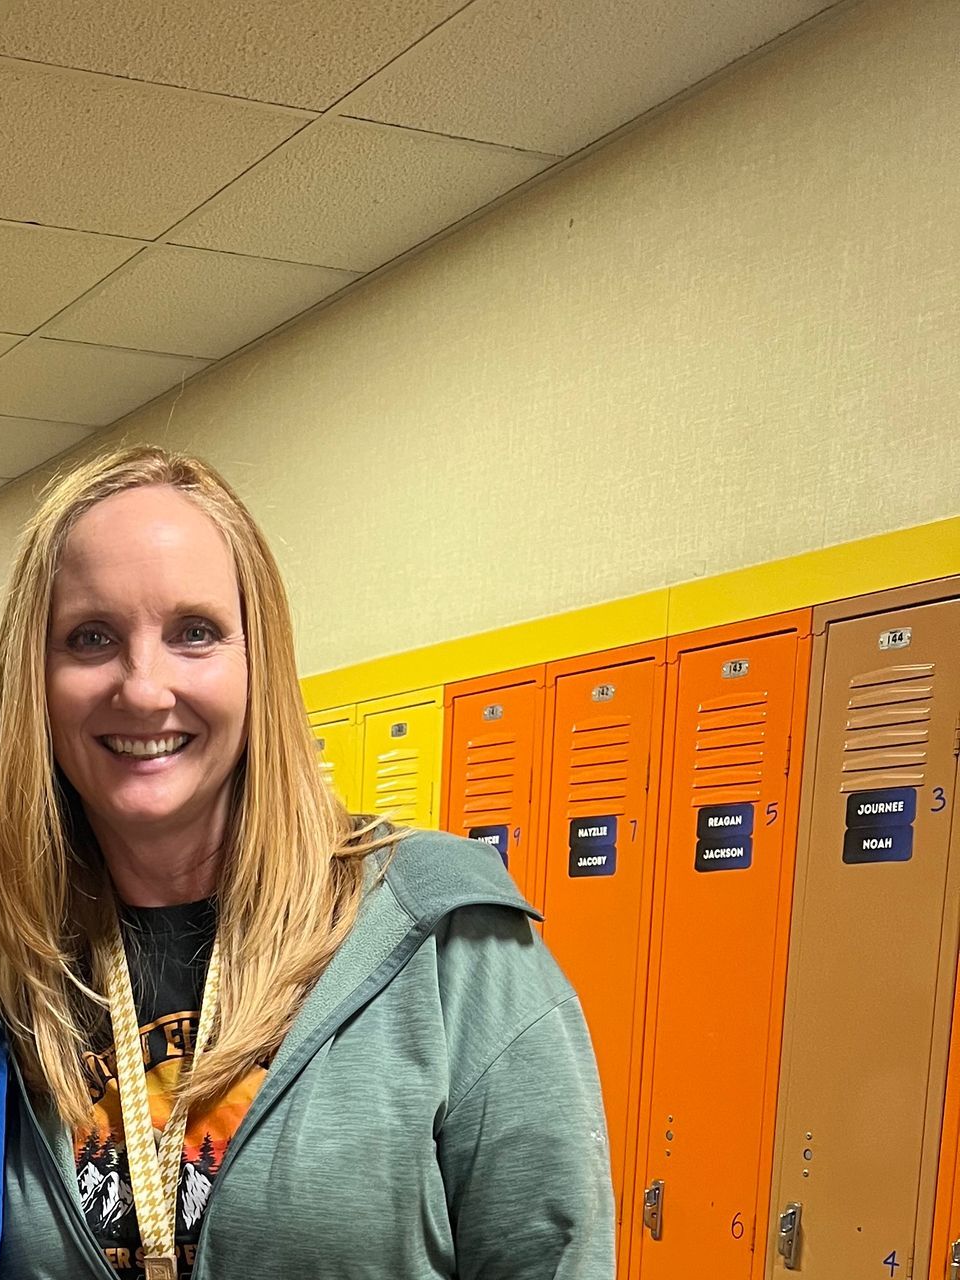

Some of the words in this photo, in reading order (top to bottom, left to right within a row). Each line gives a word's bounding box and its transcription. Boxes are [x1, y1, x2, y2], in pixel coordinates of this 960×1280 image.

[887, 632, 904, 645] 144
[729, 663, 742, 674] 143
[930, 787, 946, 812] 3
[765, 802, 778, 826] 5
[857, 801, 905, 816] JOURNEE
[708, 815, 742, 828] REAGAN
[513, 827, 521, 847] 9
[630, 820, 638, 842] 7
[862, 837, 893, 851] NOAH
[703, 847, 744, 860] JACKSON
[577, 856, 607, 867] JACOBY
[731, 1212, 744, 1240] 6
[883, 1250, 900, 1277] 4
